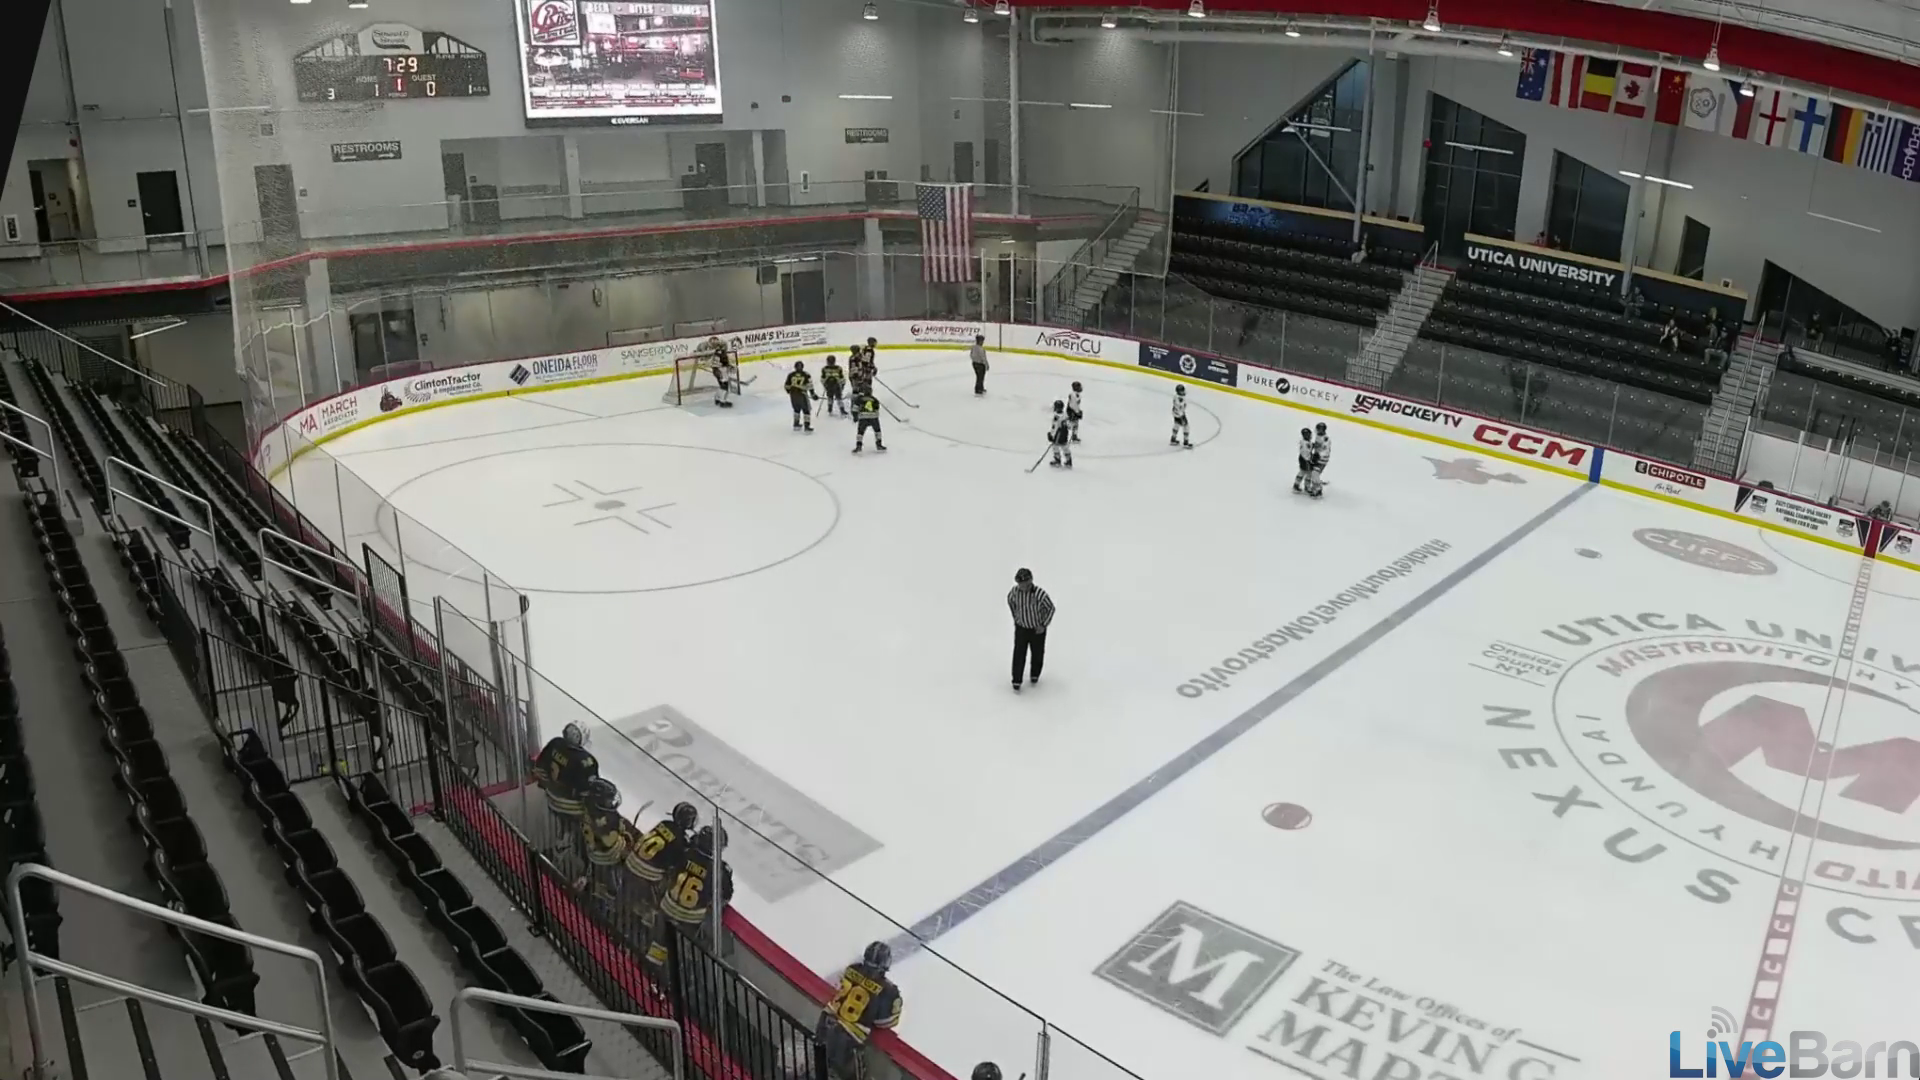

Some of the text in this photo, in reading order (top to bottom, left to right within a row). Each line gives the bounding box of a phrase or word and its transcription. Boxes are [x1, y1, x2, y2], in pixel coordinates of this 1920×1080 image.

[383, 57, 418, 73] 7:29
[411, 74, 436, 82] GUEST
[426, 81, 436, 97] 0
[327, 88, 336, 100] 3
[333, 142, 399, 154] RESTROOMS
[1467, 246, 1616, 287] UTICA UNIVERSITY
[744, 330, 774, 344] NINA'S
[776, 329, 800, 339] Pizza
[1036, 331, 1101, 354] AmeriCU
[532, 354, 598, 375] ONEIDA FLOOR
[414, 372, 481, 391] ClintonTractor
[1246, 373, 1274, 388] PURE
[1292, 384, 1339, 402] HOCKEY
[321, 396, 358, 420] MARCH
[300, 413, 318, 439] MA
[1472, 424, 1587, 466] CCM
[1650, 466, 1704, 487] CHIPOTLE
[1541, 612, 1727, 646] UTICA
[1495, 662, 1530, 676] NY
[1595, 638, 1832, 677] MASTROVITO
[1481, 703, 1741, 904] NEXUS
[1813, 860, 1920, 890] ITO
[670, 872, 703, 909] 16
[1127, 922, 1265, 1011] M
[1321, 958, 1522, 1043] The Law Offices of
[1291, 976, 1501, 1075] KEVIN
